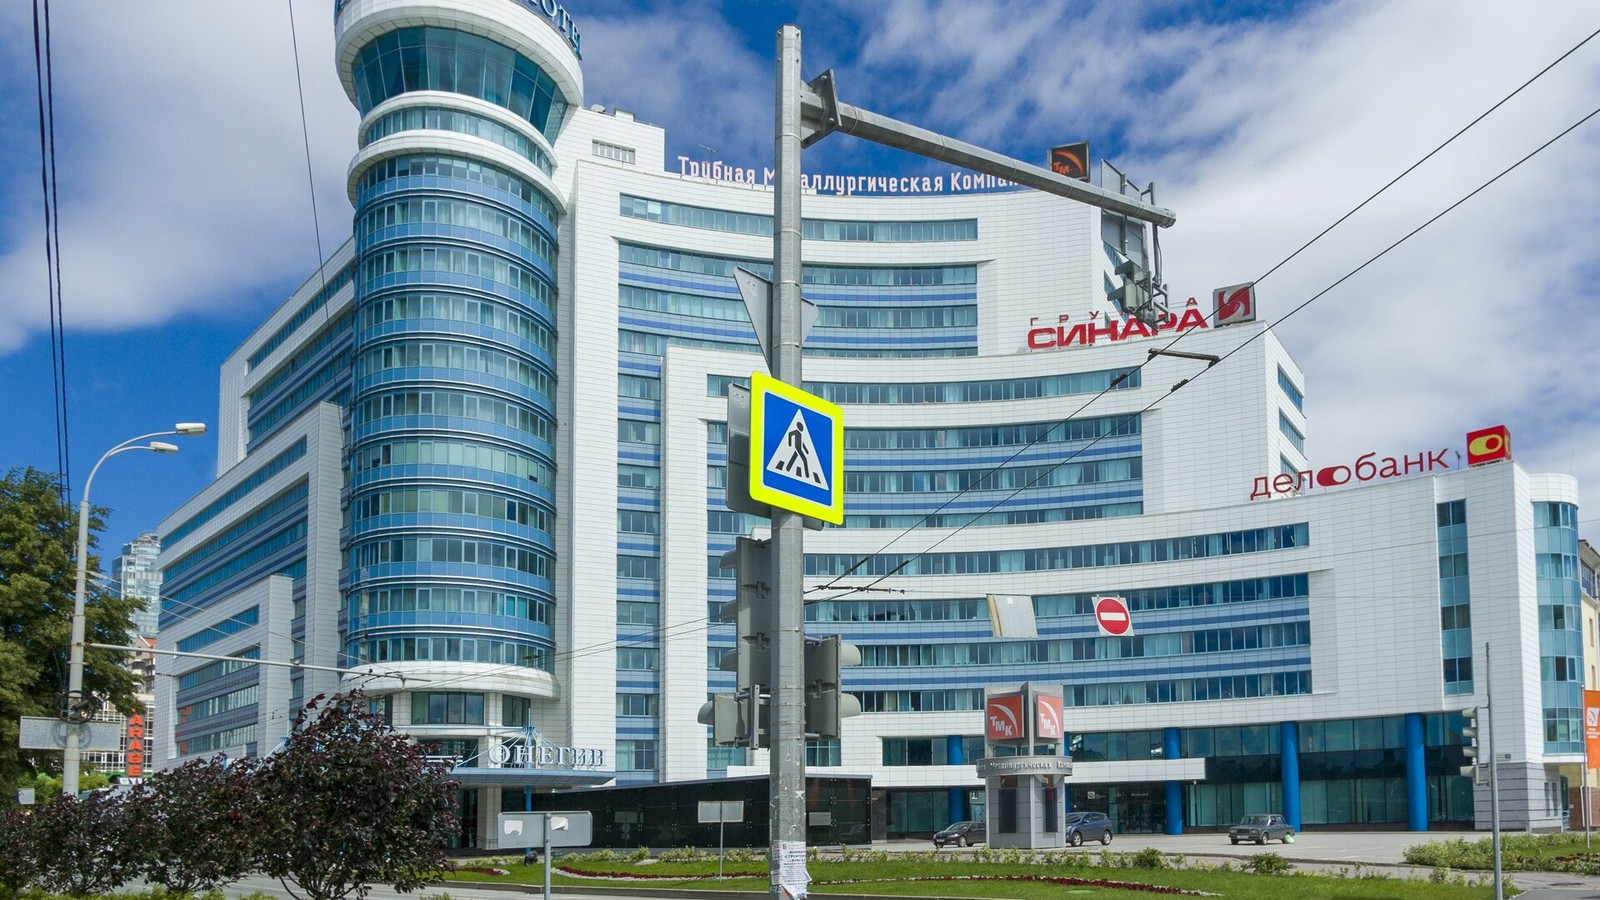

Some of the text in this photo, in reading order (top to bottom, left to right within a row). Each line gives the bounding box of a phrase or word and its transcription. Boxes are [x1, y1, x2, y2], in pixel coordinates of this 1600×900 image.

[678, 156, 755, 185] Трубная
[764, 167, 943, 196] Маллургическая
[1028, 308, 1208, 349] СИНАРА
[990, 715, 1013, 736] ТМК
[1039, 712, 1057, 736] ТМК
[128, 707, 144, 777] ARAGE
[488, 744, 608, 767] ОНЕГИН
